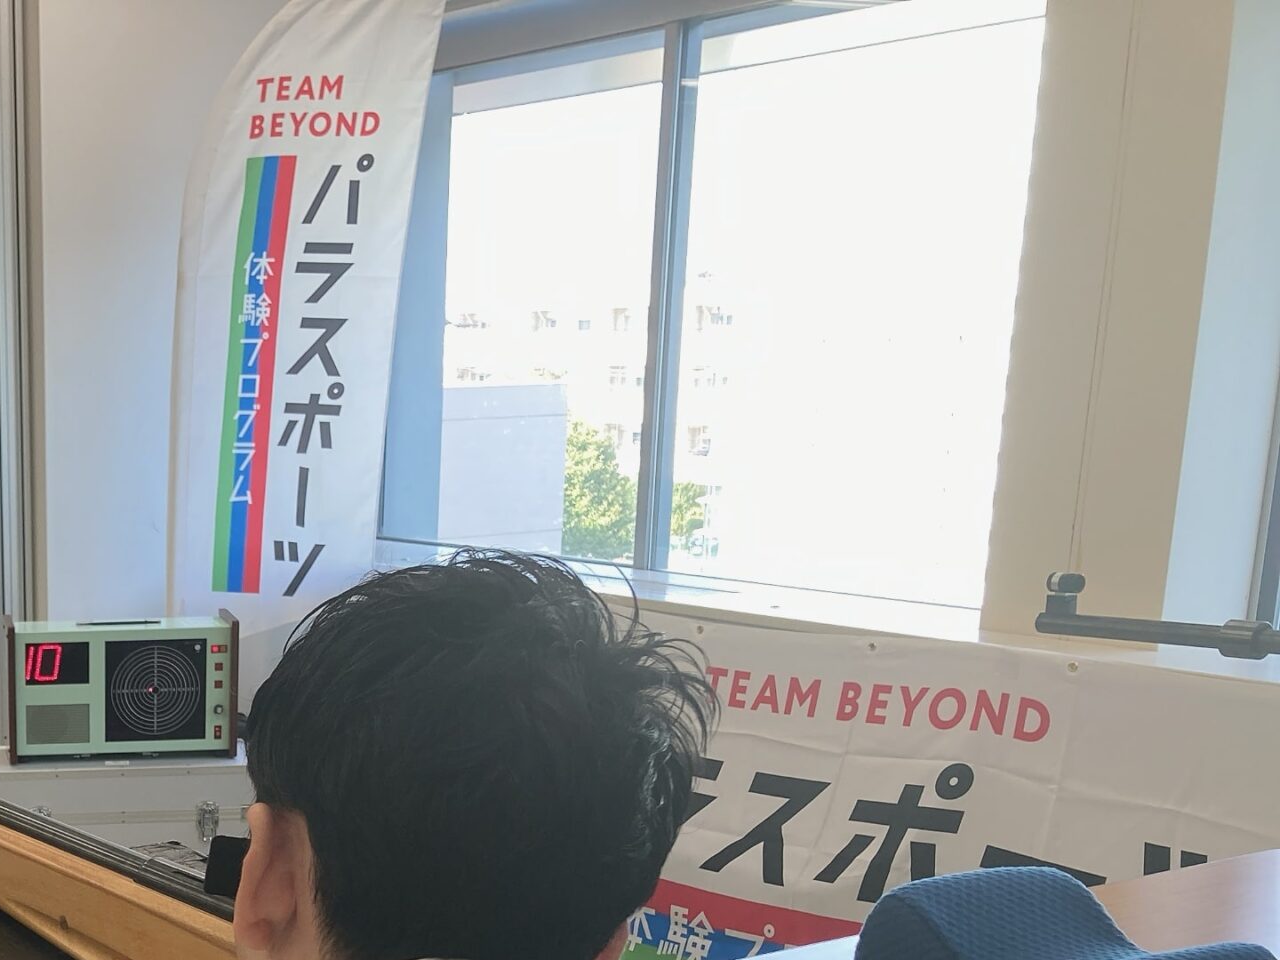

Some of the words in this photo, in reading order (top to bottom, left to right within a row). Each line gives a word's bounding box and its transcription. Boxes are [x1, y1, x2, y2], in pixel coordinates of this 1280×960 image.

[256, 74, 345, 103] TEAM
[249, 111, 381, 140] BEYOND
[228, 251, 276, 505] 体験プログラム
[273, 153, 375, 597] パラスポーツ
[25, 643, 63, 682] 10
[705, 666, 822, 718] TEAM
[835, 681, 1051, 743] BEYOND
